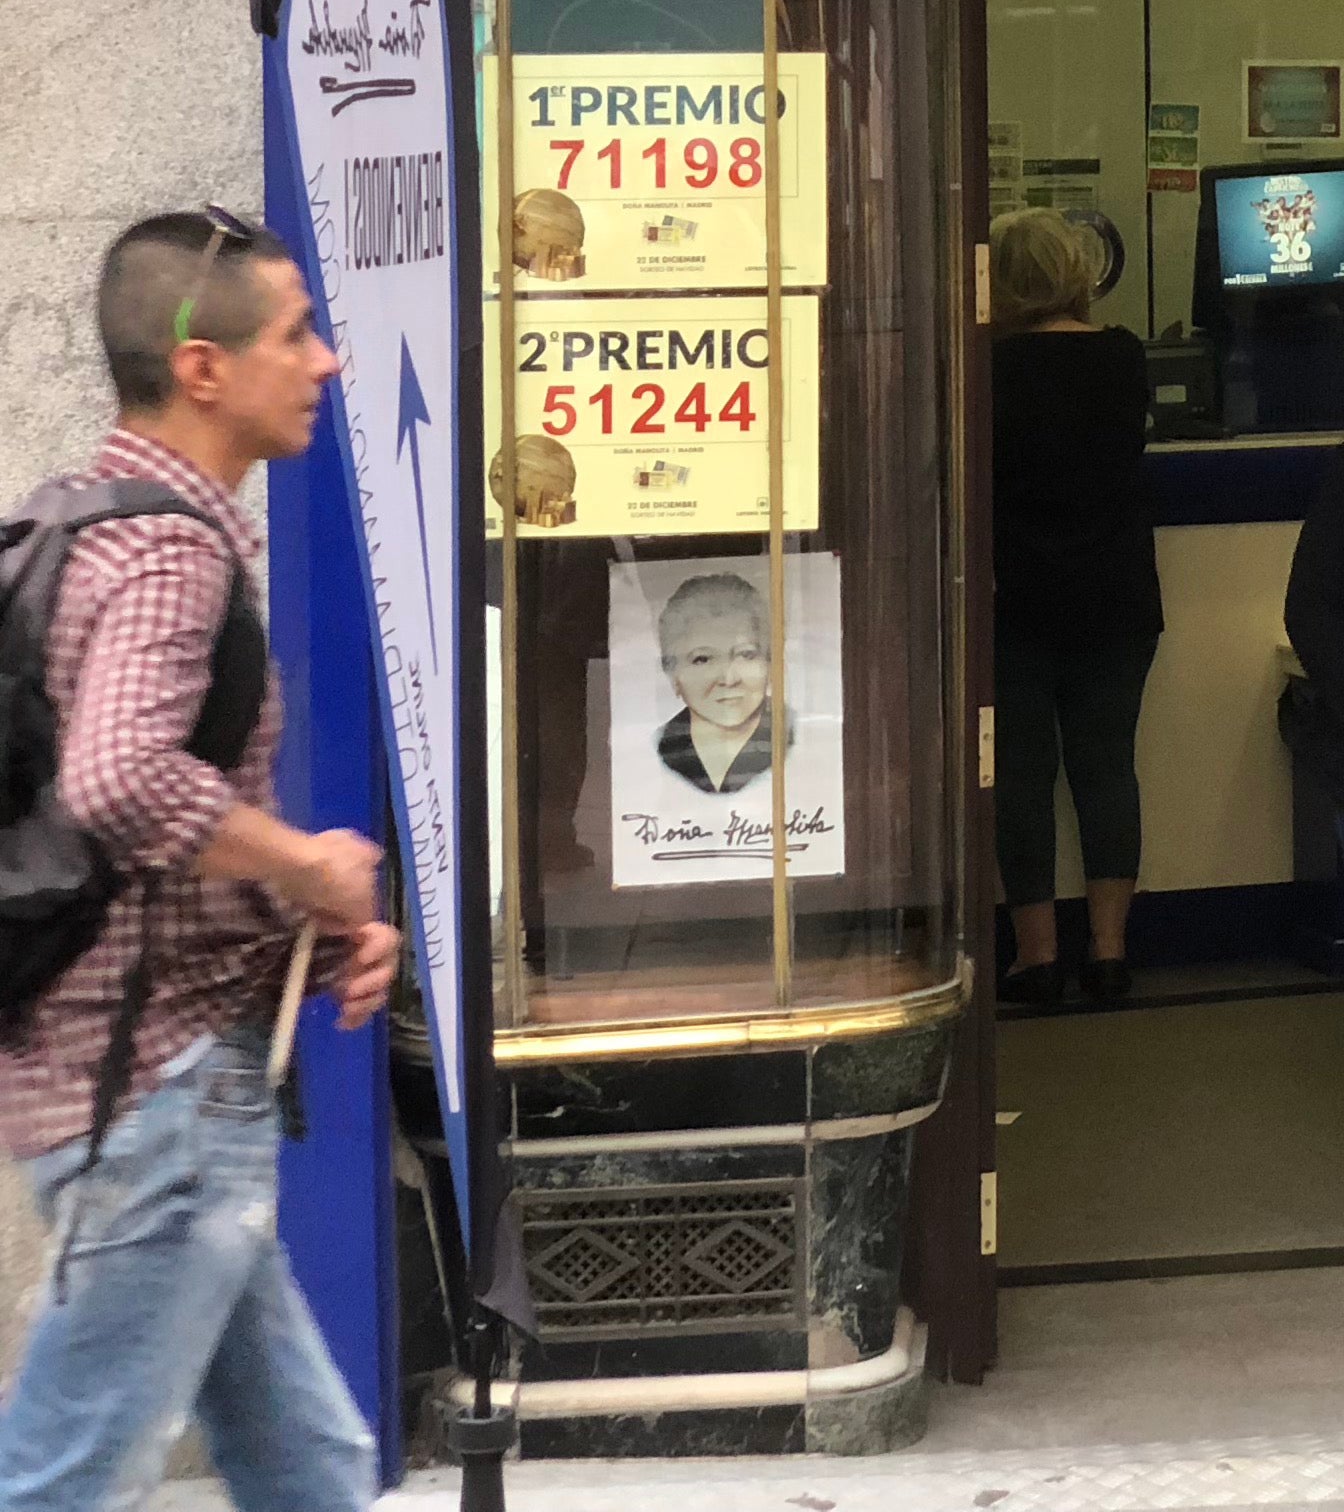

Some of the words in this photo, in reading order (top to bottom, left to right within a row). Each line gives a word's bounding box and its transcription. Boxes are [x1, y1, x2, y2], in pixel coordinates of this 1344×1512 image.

[571, 84, 787, 128] PREMIO
[549, 136, 763, 191] 71198
[649, 256, 660, 264] DE
[662, 256, 706, 264] DICIEMBRE
[1270, 232, 1312, 263] 36
[563, 329, 769, 372] PREMIO
[542, 381, 757, 436] 51244
[640, 501, 650, 509] DE
[653, 501, 698, 509] DICIEMBRE
[621, 813, 713, 845] Doña
